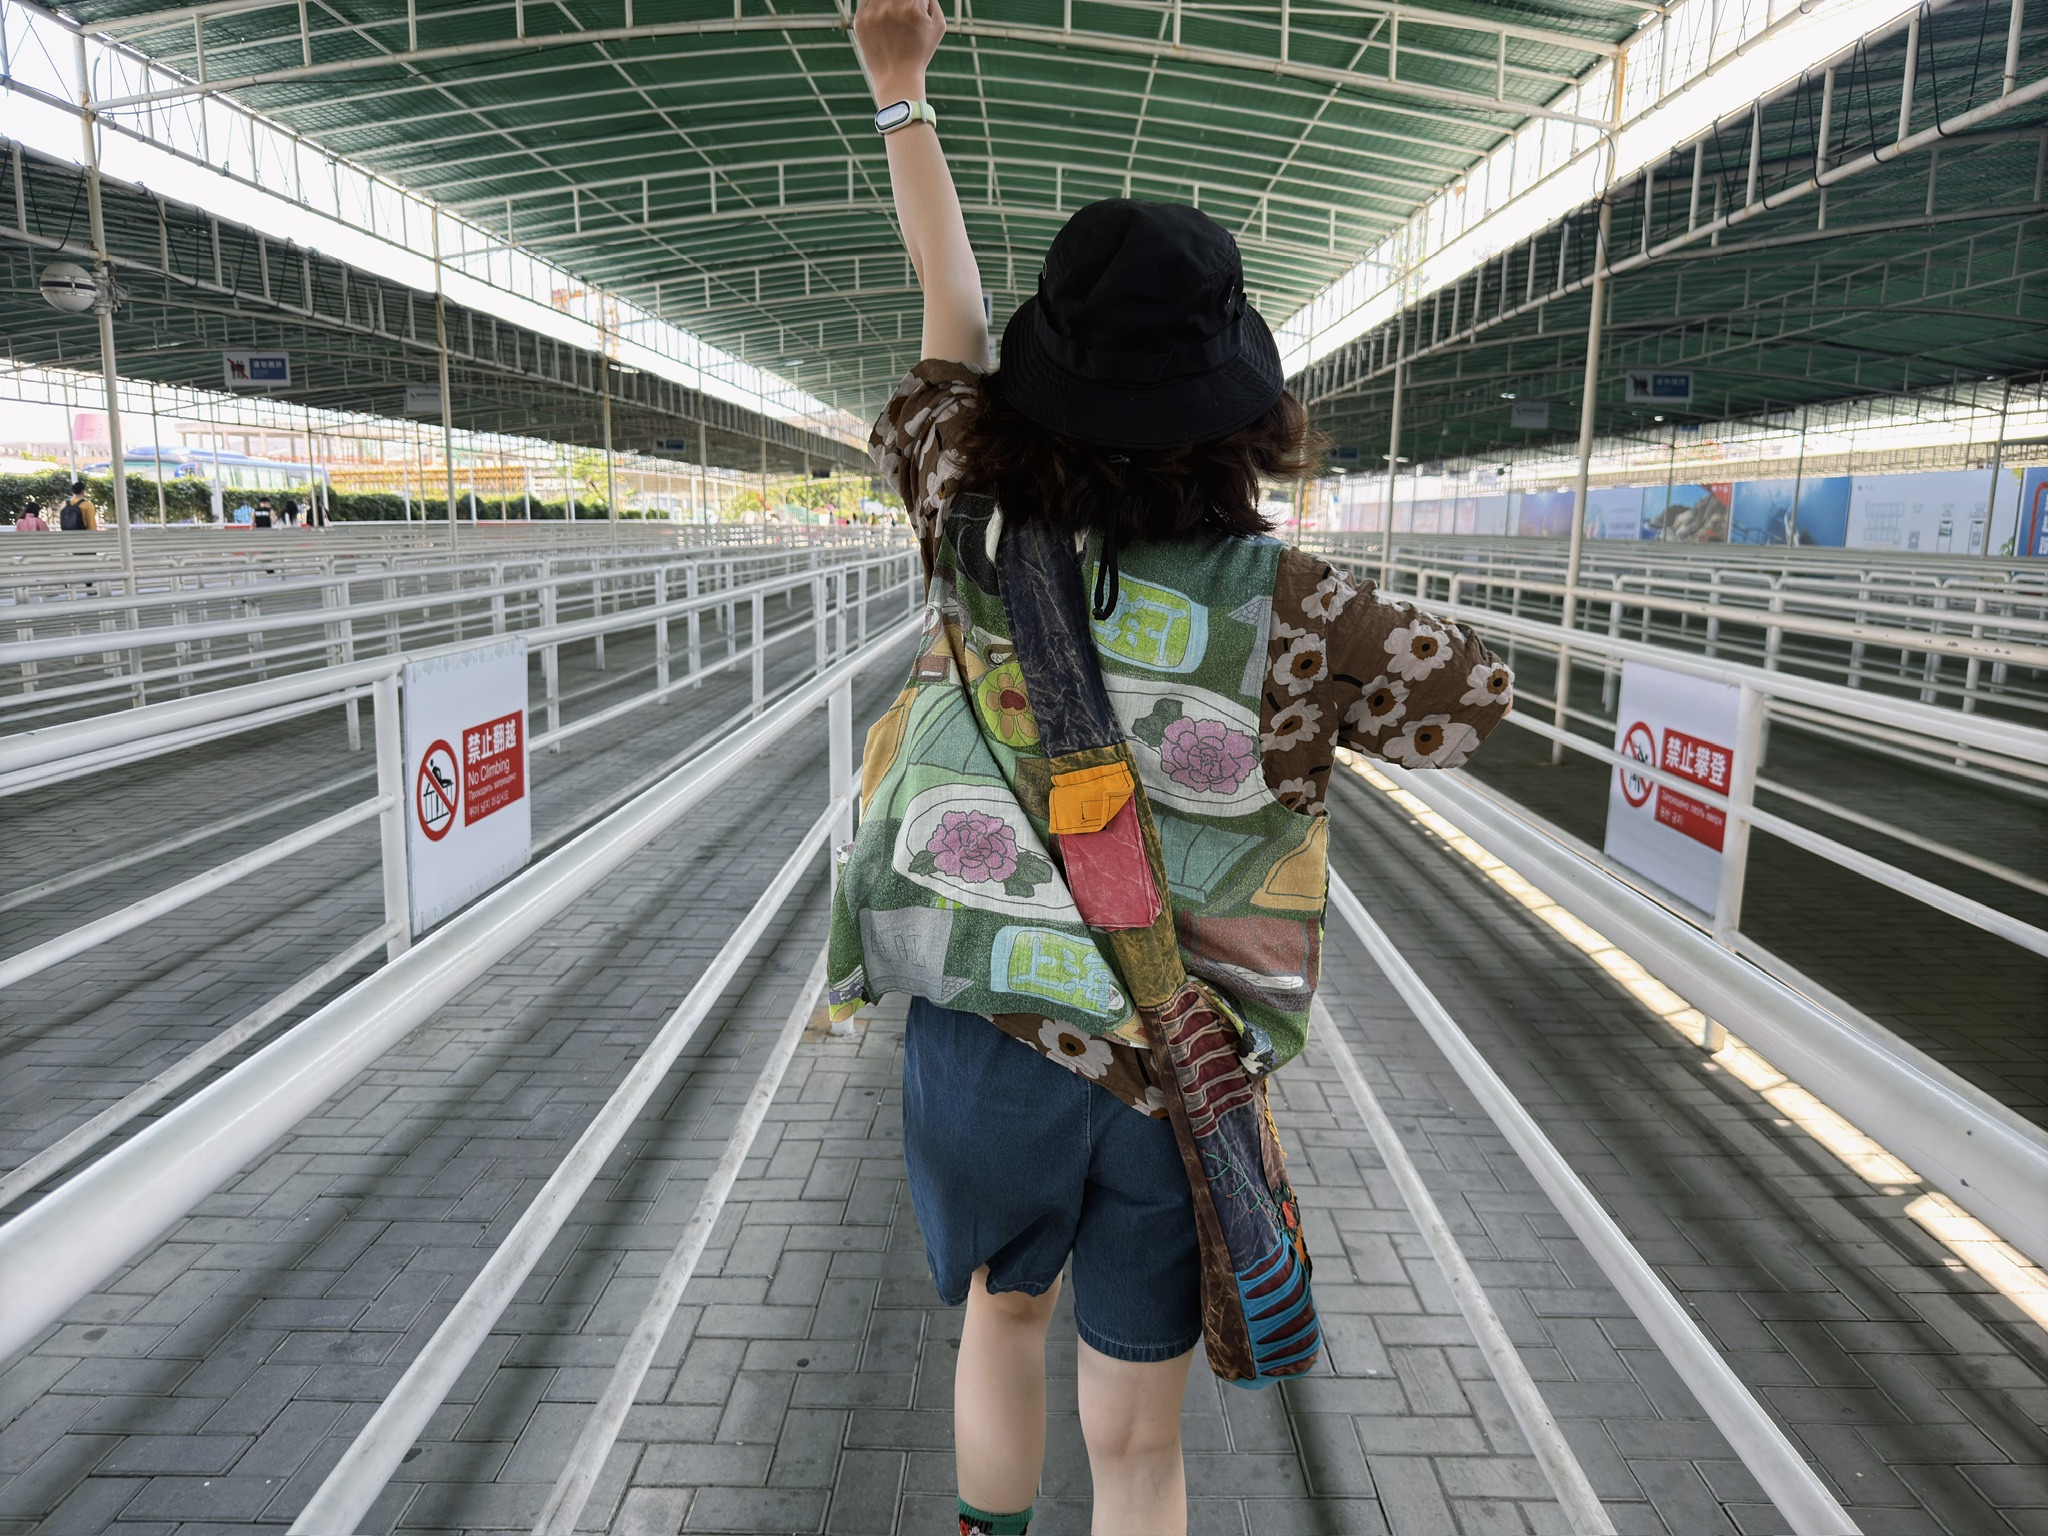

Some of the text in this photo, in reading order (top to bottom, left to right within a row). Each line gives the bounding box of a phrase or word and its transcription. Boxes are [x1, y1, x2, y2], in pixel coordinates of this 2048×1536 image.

[468, 719, 517, 765] 禁止翻越
[1666, 736, 1726, 787] 禁止攀登
[468, 758, 510, 788] No Climbing
